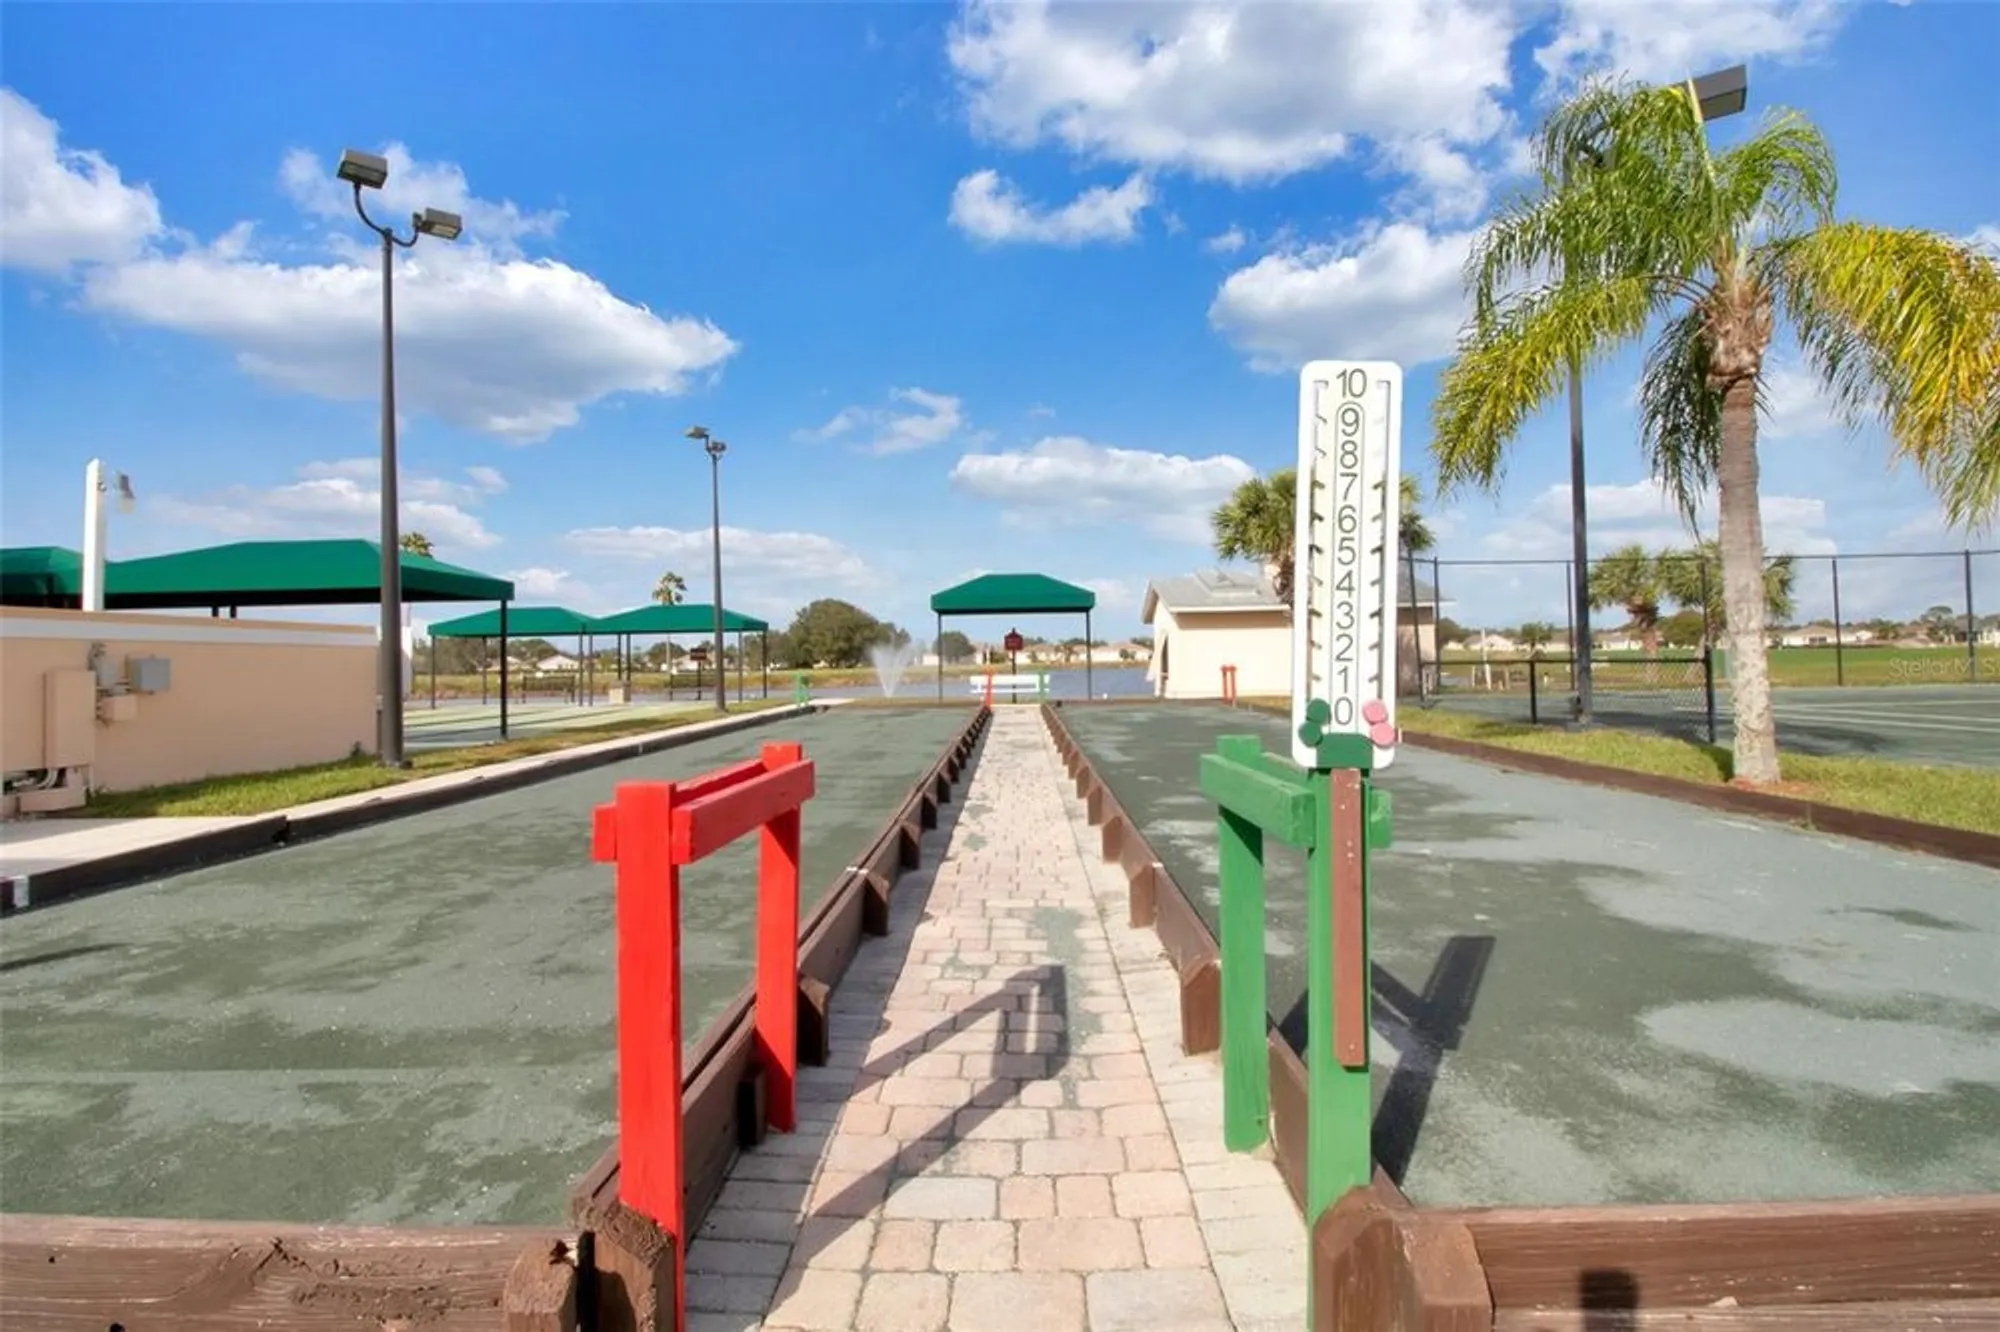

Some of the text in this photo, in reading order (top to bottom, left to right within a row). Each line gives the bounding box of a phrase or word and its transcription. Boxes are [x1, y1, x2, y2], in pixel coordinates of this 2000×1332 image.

[1336, 368, 1367, 398] 10
[1341, 408, 1359, 437] 9
[1339, 440, 1358, 469] 8
[1339, 473, 1358, 500] 7
[1337, 505, 1357, 534] 6
[1337, 537, 1355, 565] 5
[1335, 570, 1355, 597] 4
[1335, 601, 1354, 630] 3
[1335, 634, 1354, 662] 2
[1337, 666, 1348, 693] 1
[1334, 697, 1353, 726] 0
